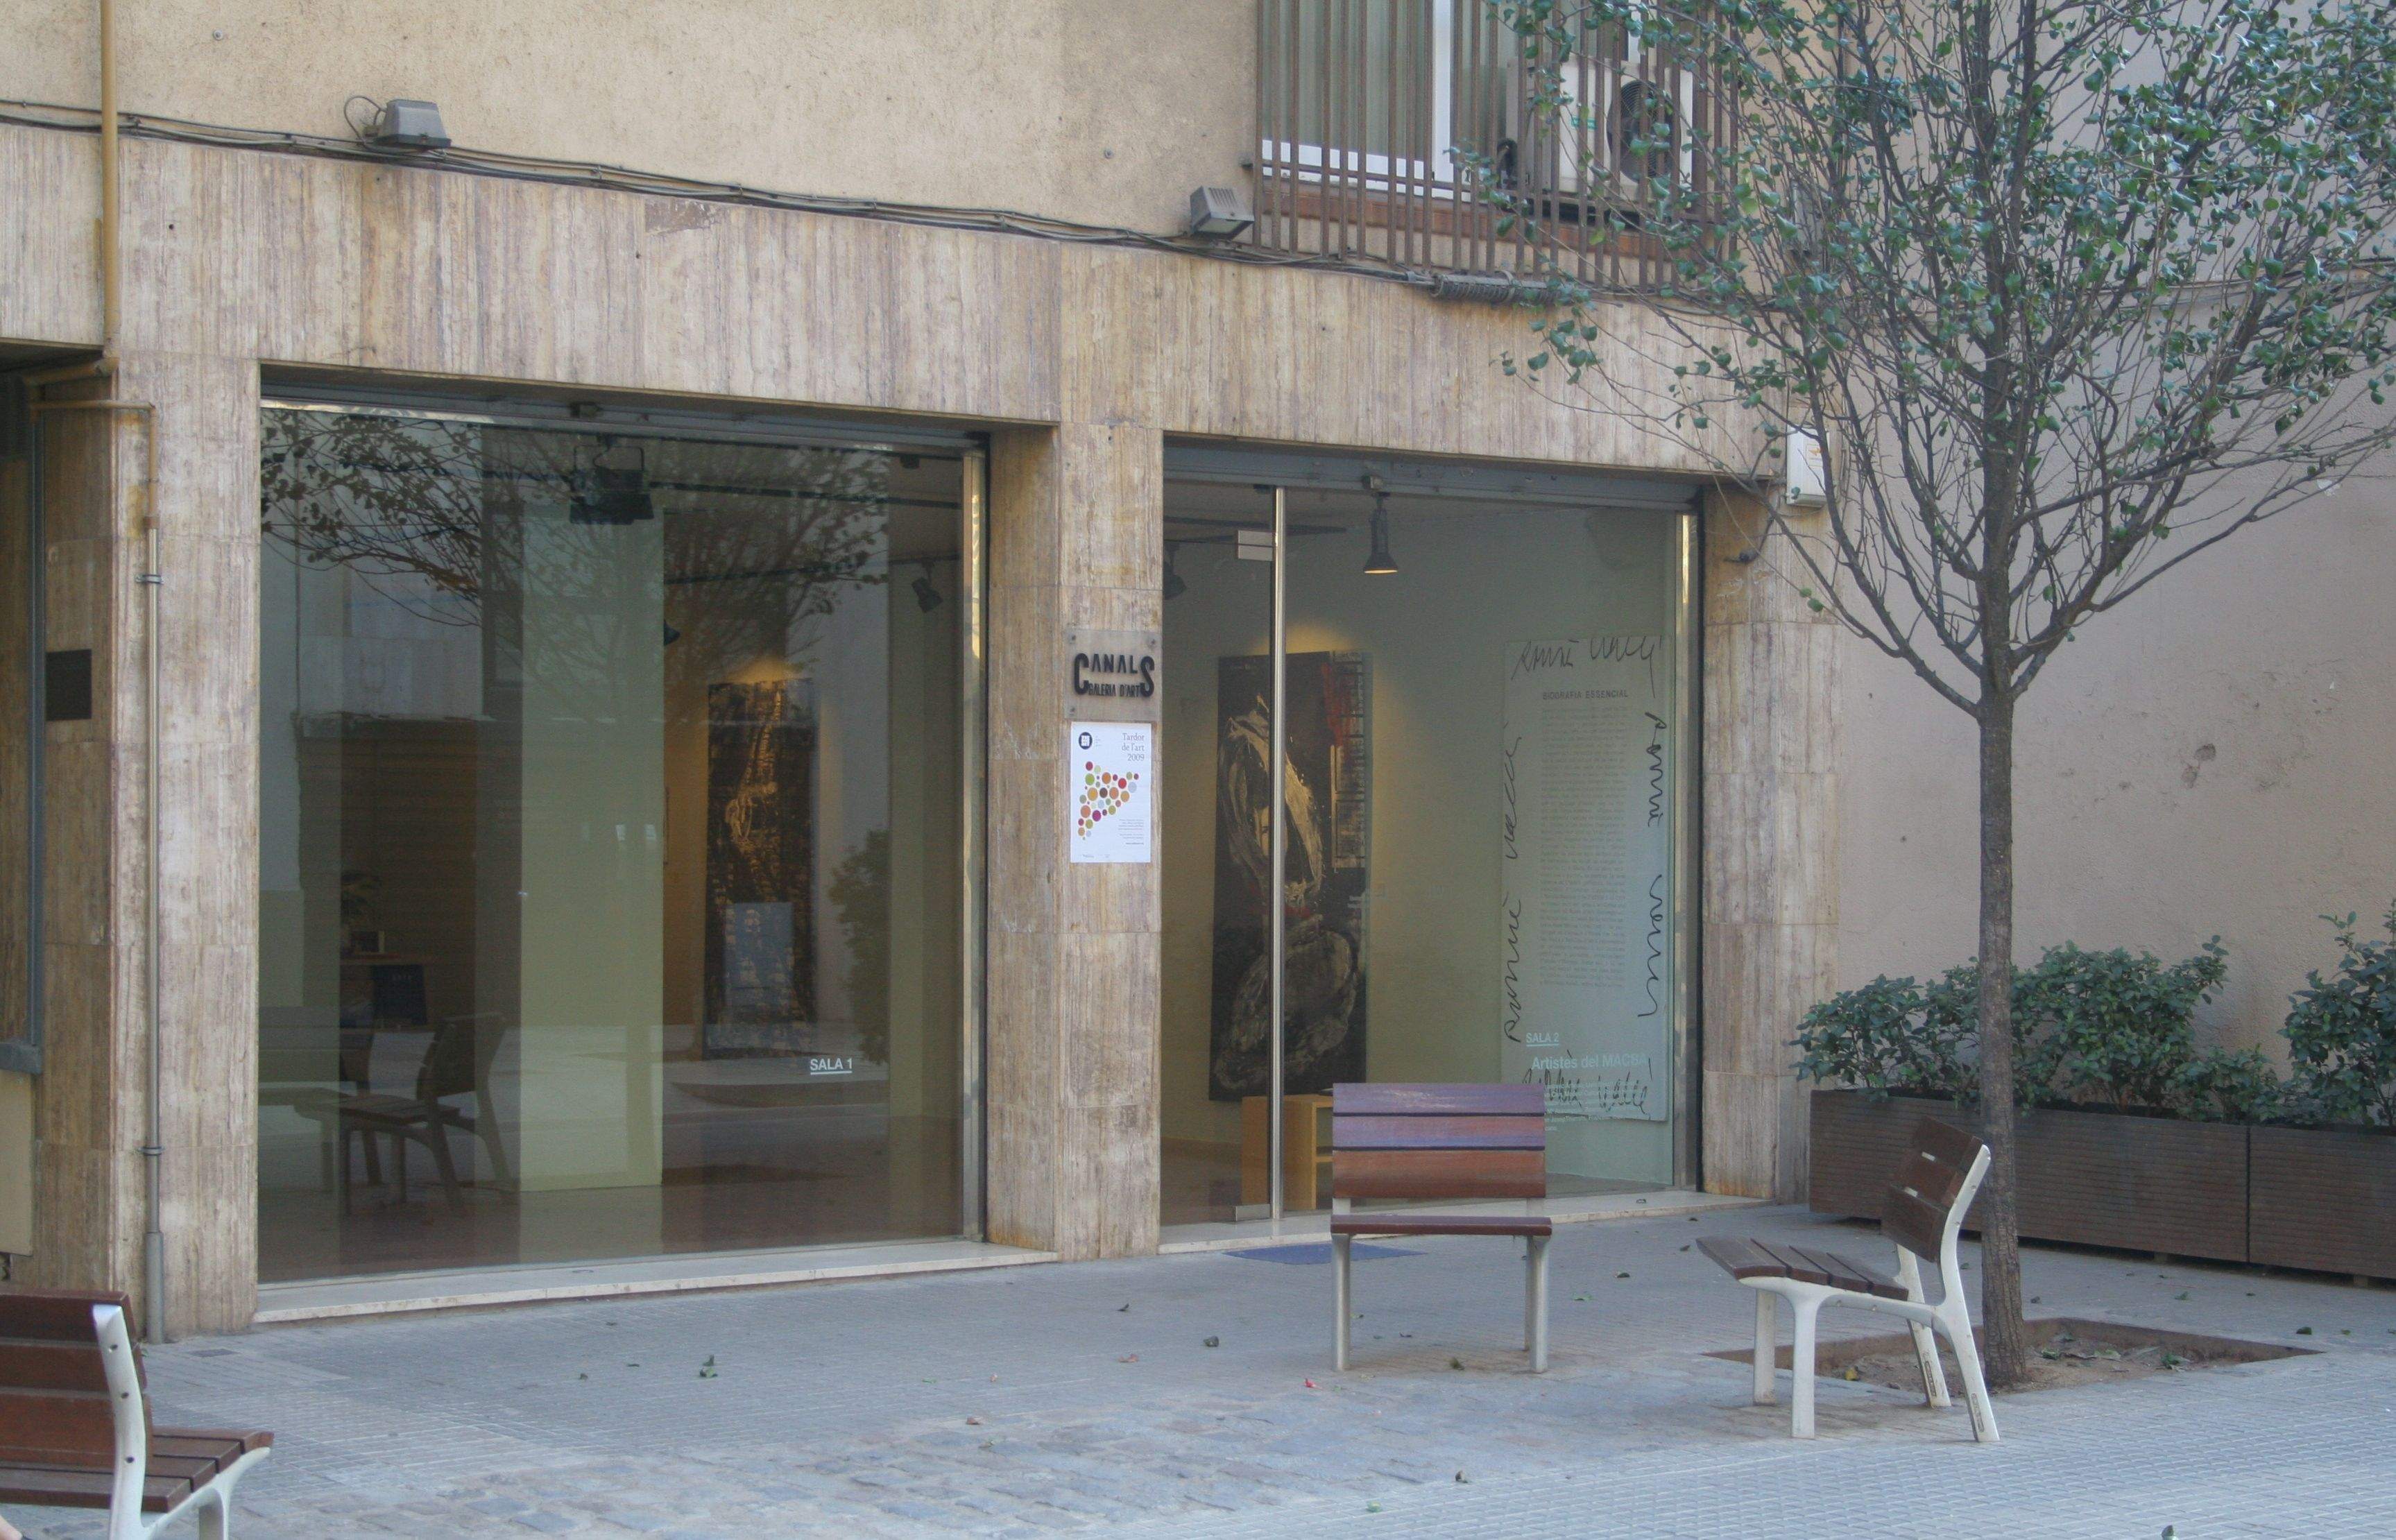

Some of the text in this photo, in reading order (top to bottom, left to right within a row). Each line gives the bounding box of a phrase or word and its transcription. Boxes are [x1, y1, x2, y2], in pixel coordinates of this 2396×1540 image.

[1074, 653, 1154, 696] CANALS
[1088, 683, 1140, 697] GALERIA D'ART
[1543, 690, 1628, 700] BIOGRAFIA ESSENCIAL
[1122, 733, 1145, 742] Tardor
[1121, 743, 1129, 751] de
[1127, 753, 1145, 762] 2009
[1526, 1032, 1559, 1043] SALA 2
[810, 1058, 853, 1071] SALA 1
[1581, 1055, 1599, 1068] del
